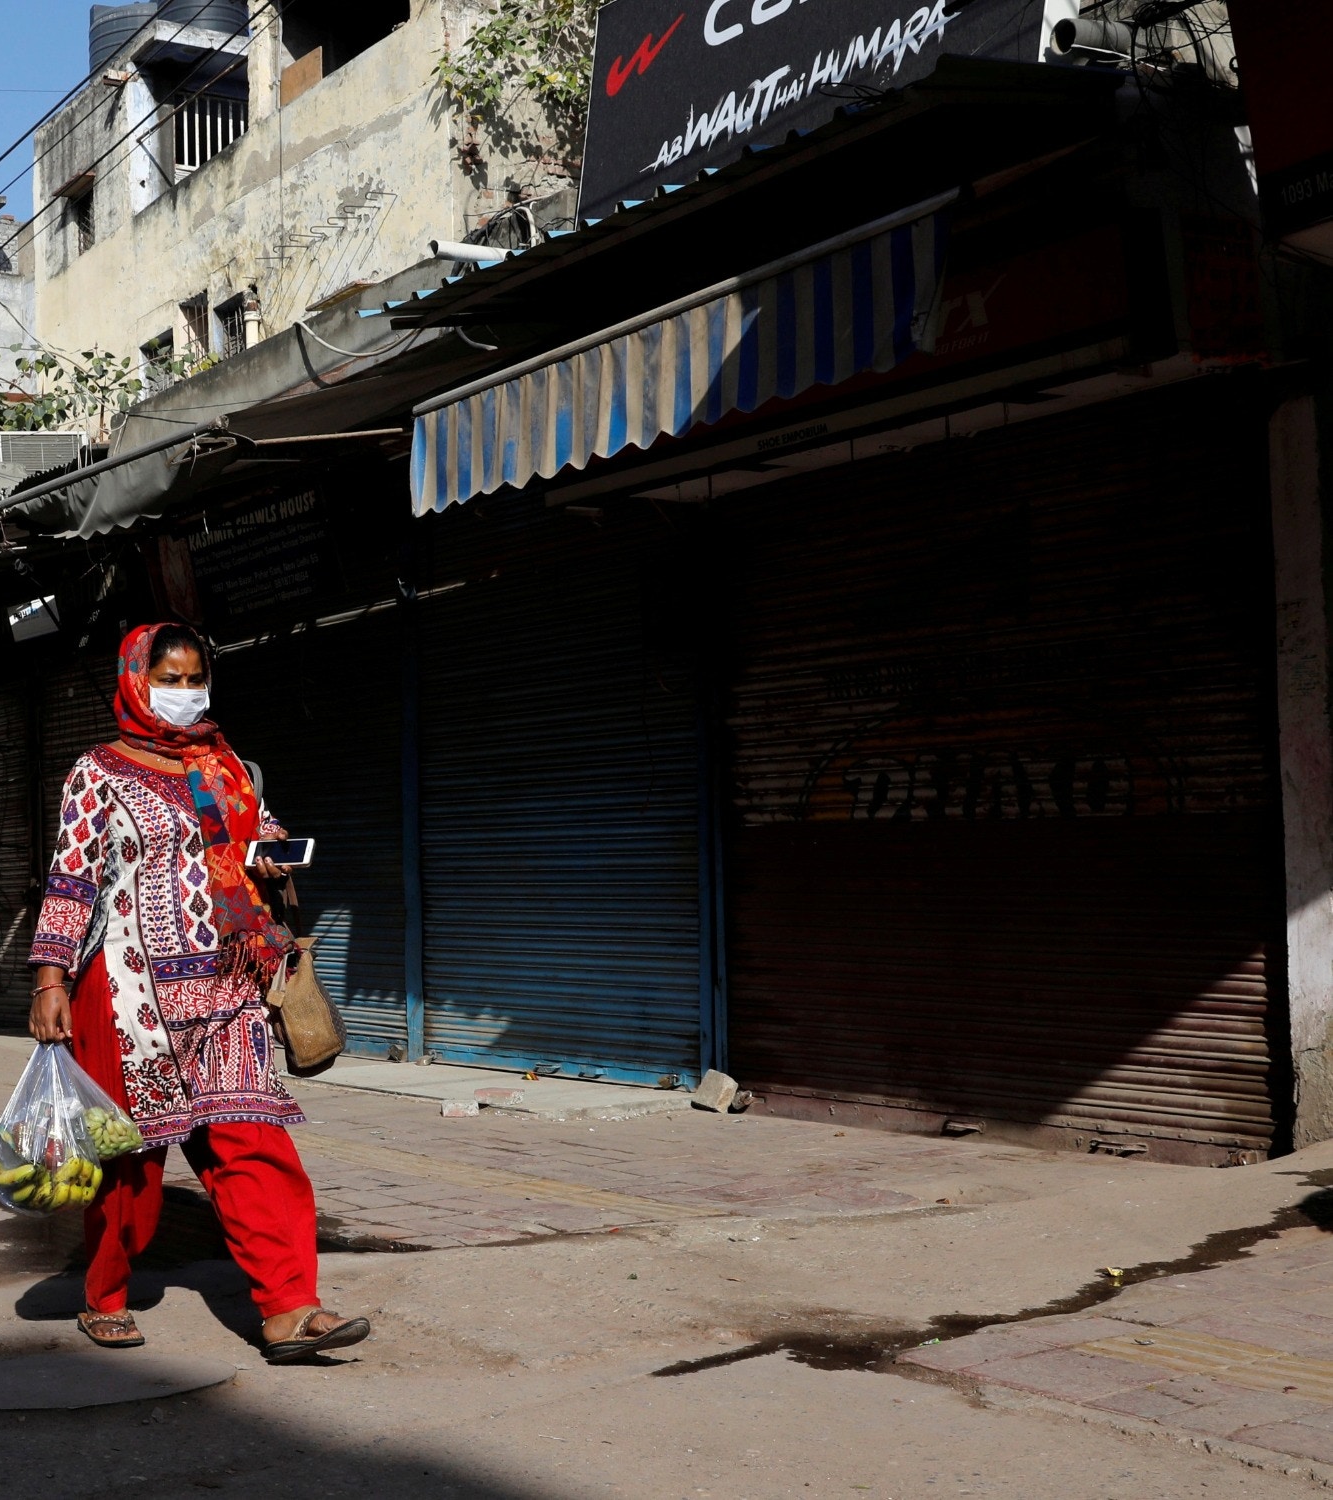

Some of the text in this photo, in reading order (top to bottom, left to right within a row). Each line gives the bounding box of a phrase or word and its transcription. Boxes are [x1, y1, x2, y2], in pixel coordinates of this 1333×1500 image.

[684, 65, 791, 155] WAQT
[806, 2, 963, 98] HUMARA
[1280, 178, 1313, 206] 1093
[951, 334, 977, 352] FOR
[978, 331, 990, 344] IT
[758, 423, 828, 450] SHOE EMPORIUM
